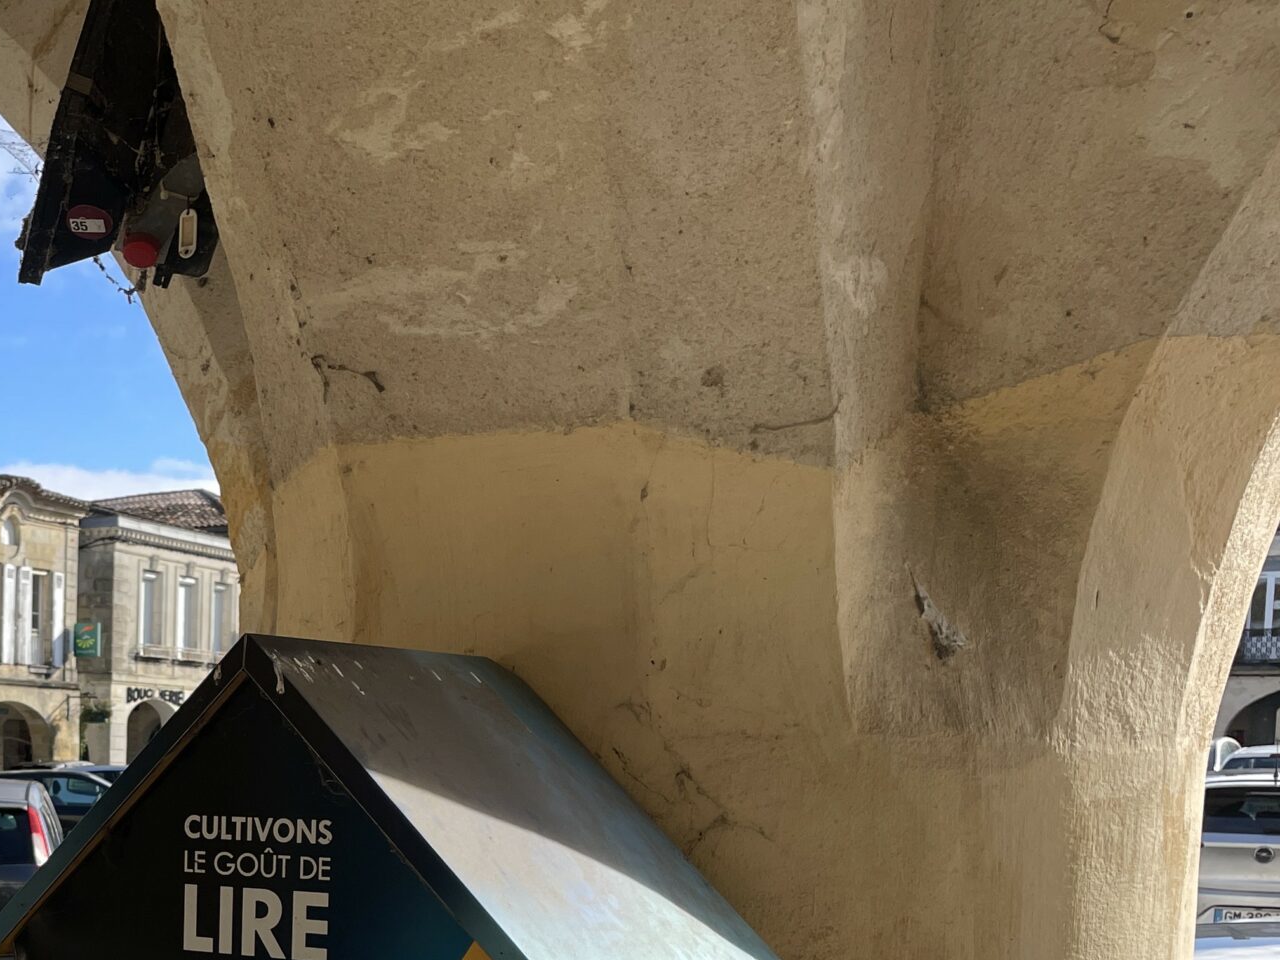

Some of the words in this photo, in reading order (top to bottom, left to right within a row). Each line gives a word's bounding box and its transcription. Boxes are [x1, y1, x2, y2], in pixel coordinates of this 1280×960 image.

[71, 220, 88, 232] 35
[183, 813, 333, 845] CULTIVONS
[183, 849, 206, 874] LE
[213, 847, 291, 879] GOÛT
[299, 855, 331, 881] DE
